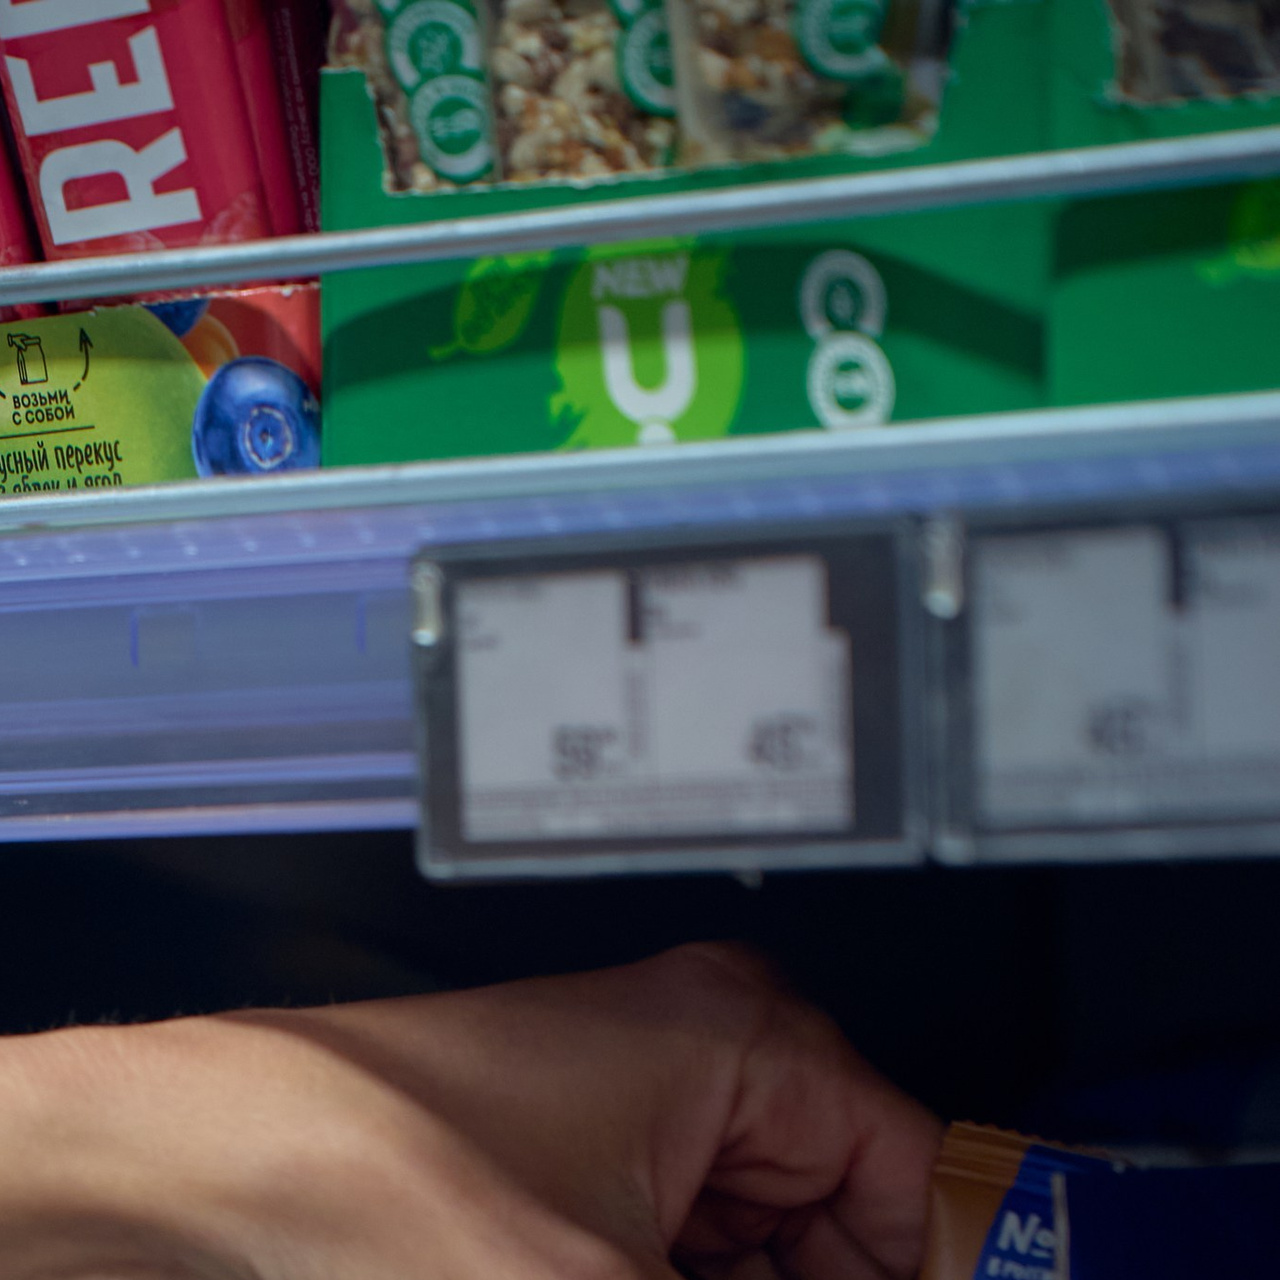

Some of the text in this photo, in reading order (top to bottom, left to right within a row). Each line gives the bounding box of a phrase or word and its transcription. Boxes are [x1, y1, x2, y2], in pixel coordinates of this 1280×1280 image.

[591, 251, 690, 301] NEW
[12, 390, 70, 410] ВОЗЬМИ
[12, 403, 76, 426] С СОБОЙ
[54, 438, 123, 471] перекус
